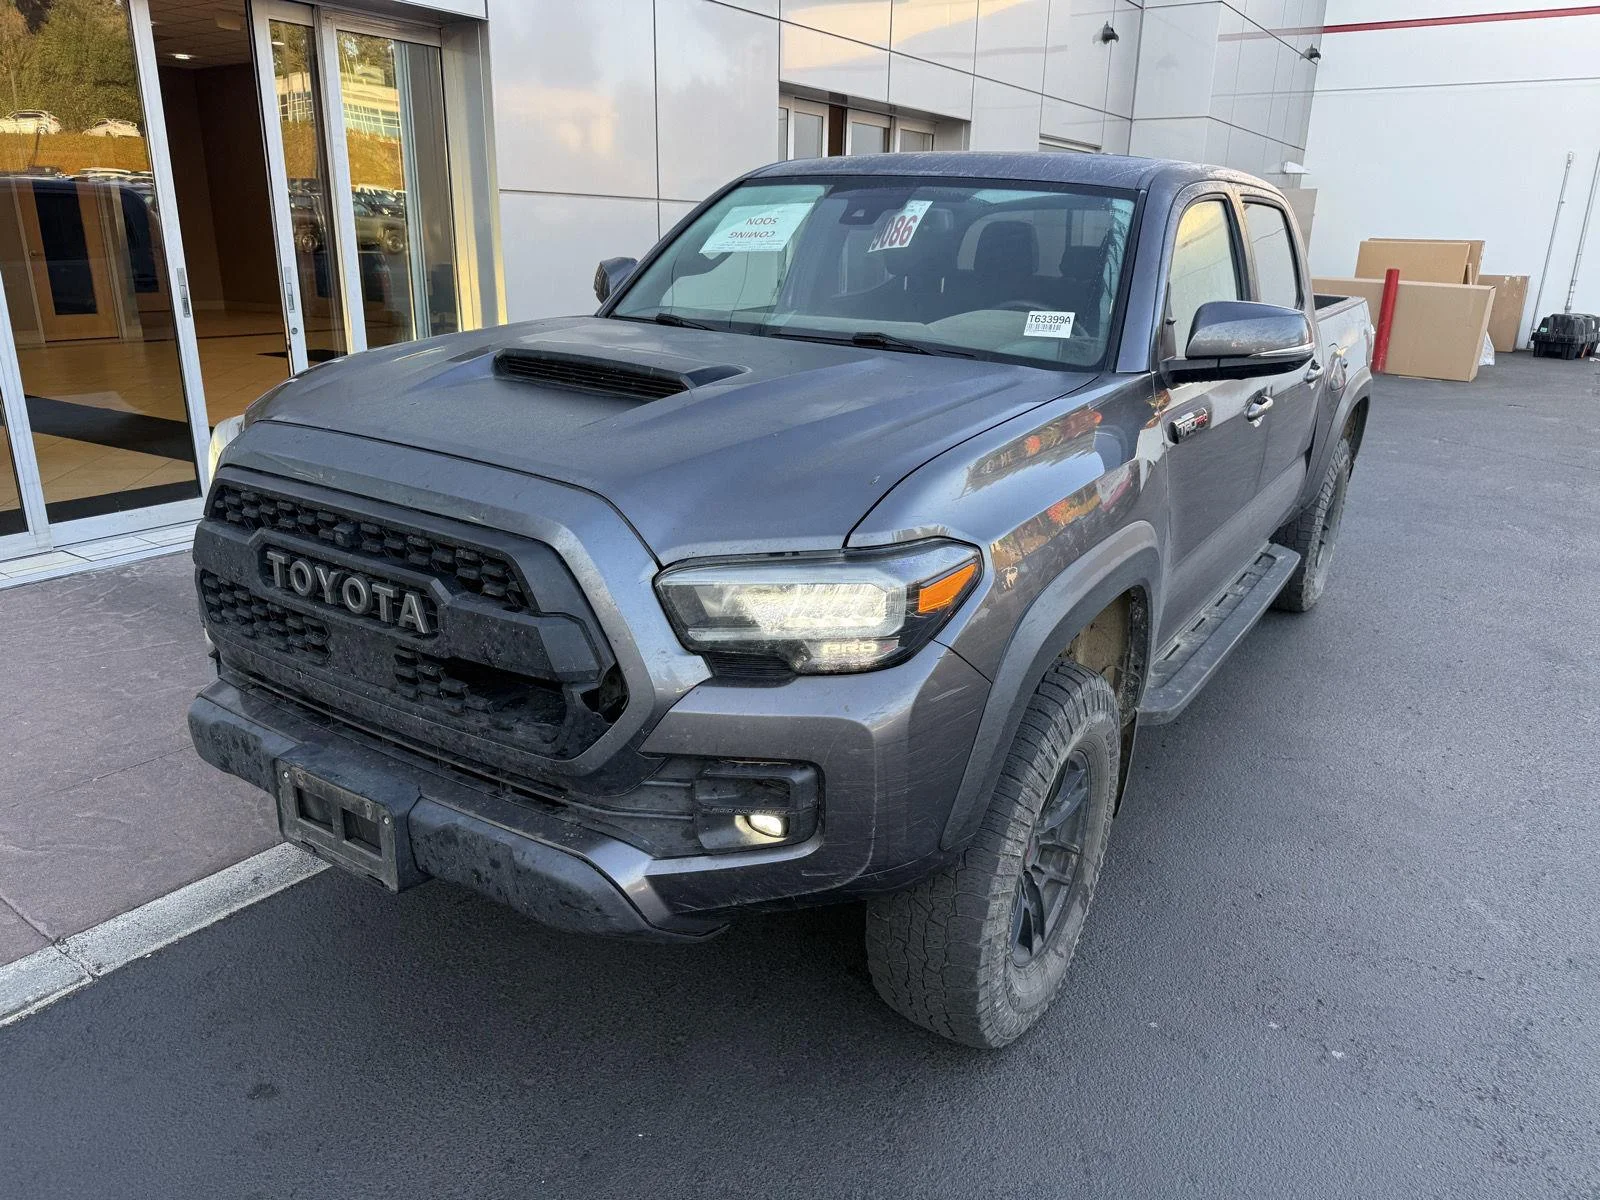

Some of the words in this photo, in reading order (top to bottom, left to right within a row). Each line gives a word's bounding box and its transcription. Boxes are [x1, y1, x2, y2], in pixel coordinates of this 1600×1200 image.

[745, 217, 779, 226] SOON
[728, 230, 776, 239] COMING
[1029, 314, 1071, 325] T63399A
[266, 551, 432, 634] TOYOTA
